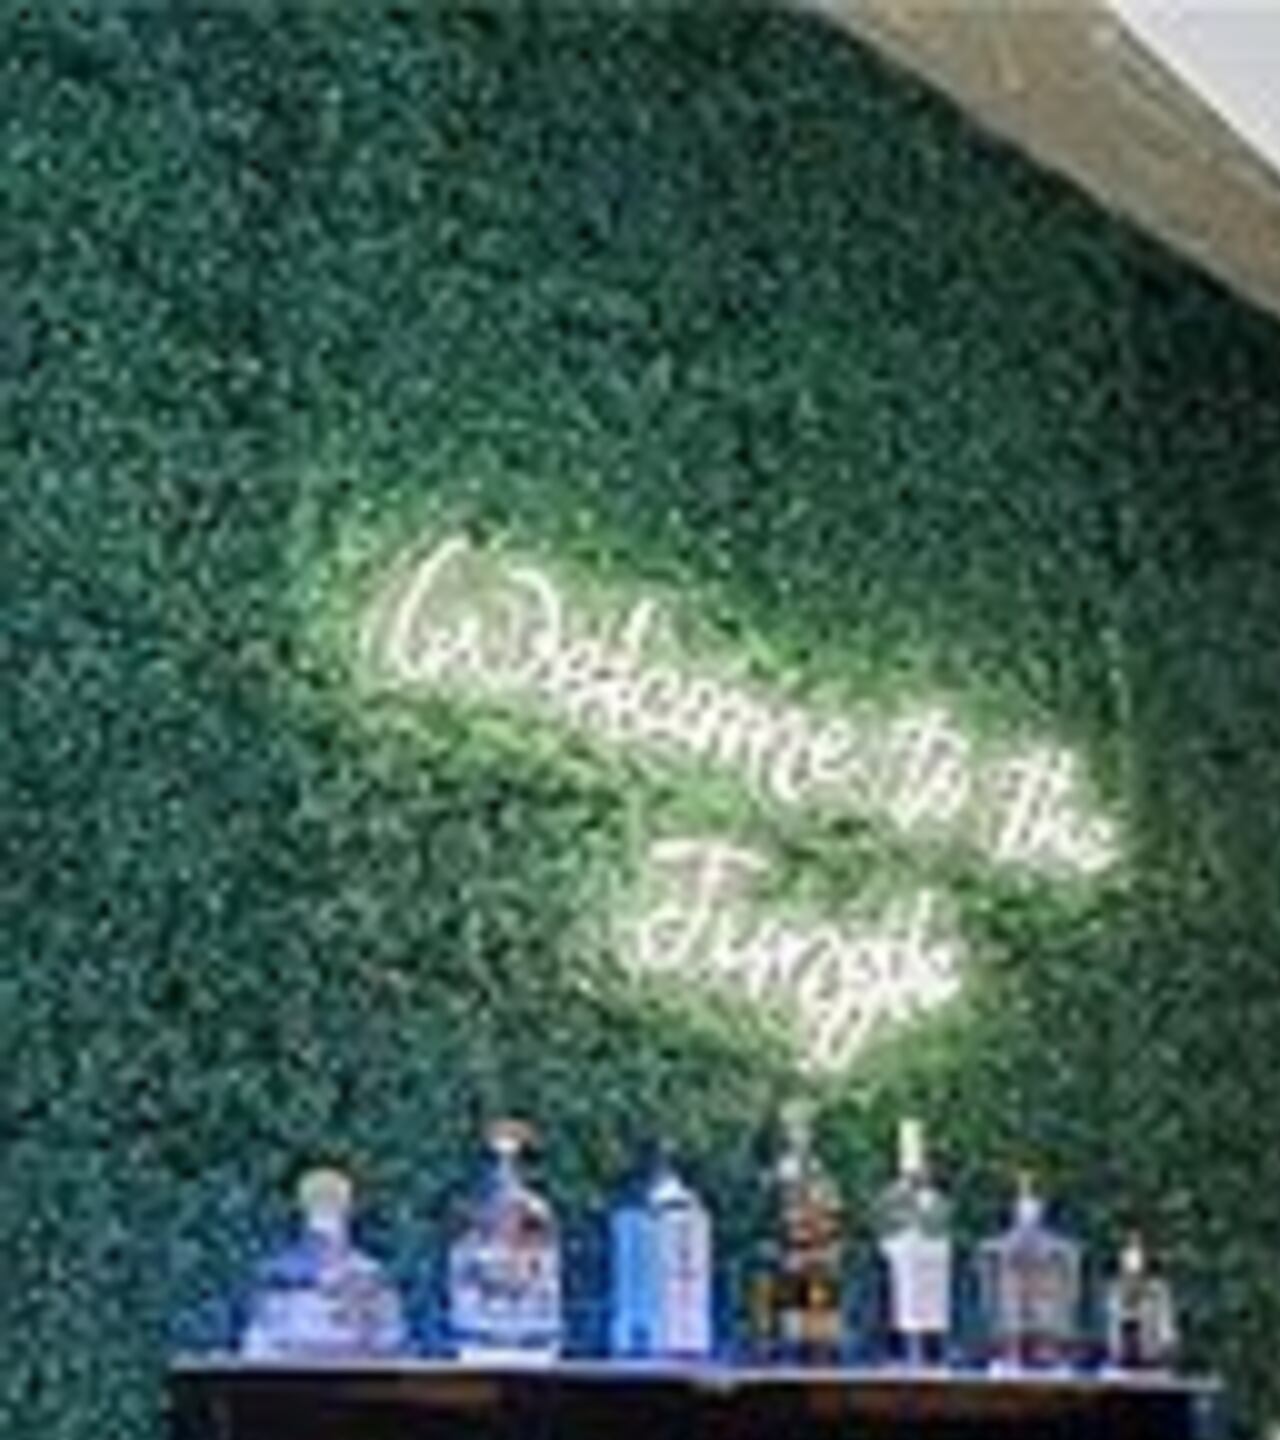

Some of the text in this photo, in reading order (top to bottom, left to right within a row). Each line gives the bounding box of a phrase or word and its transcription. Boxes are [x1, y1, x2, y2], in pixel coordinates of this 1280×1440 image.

[382, 536, 1122, 874] Welcome to the
[642, 838, 964, 1072] Jungle
